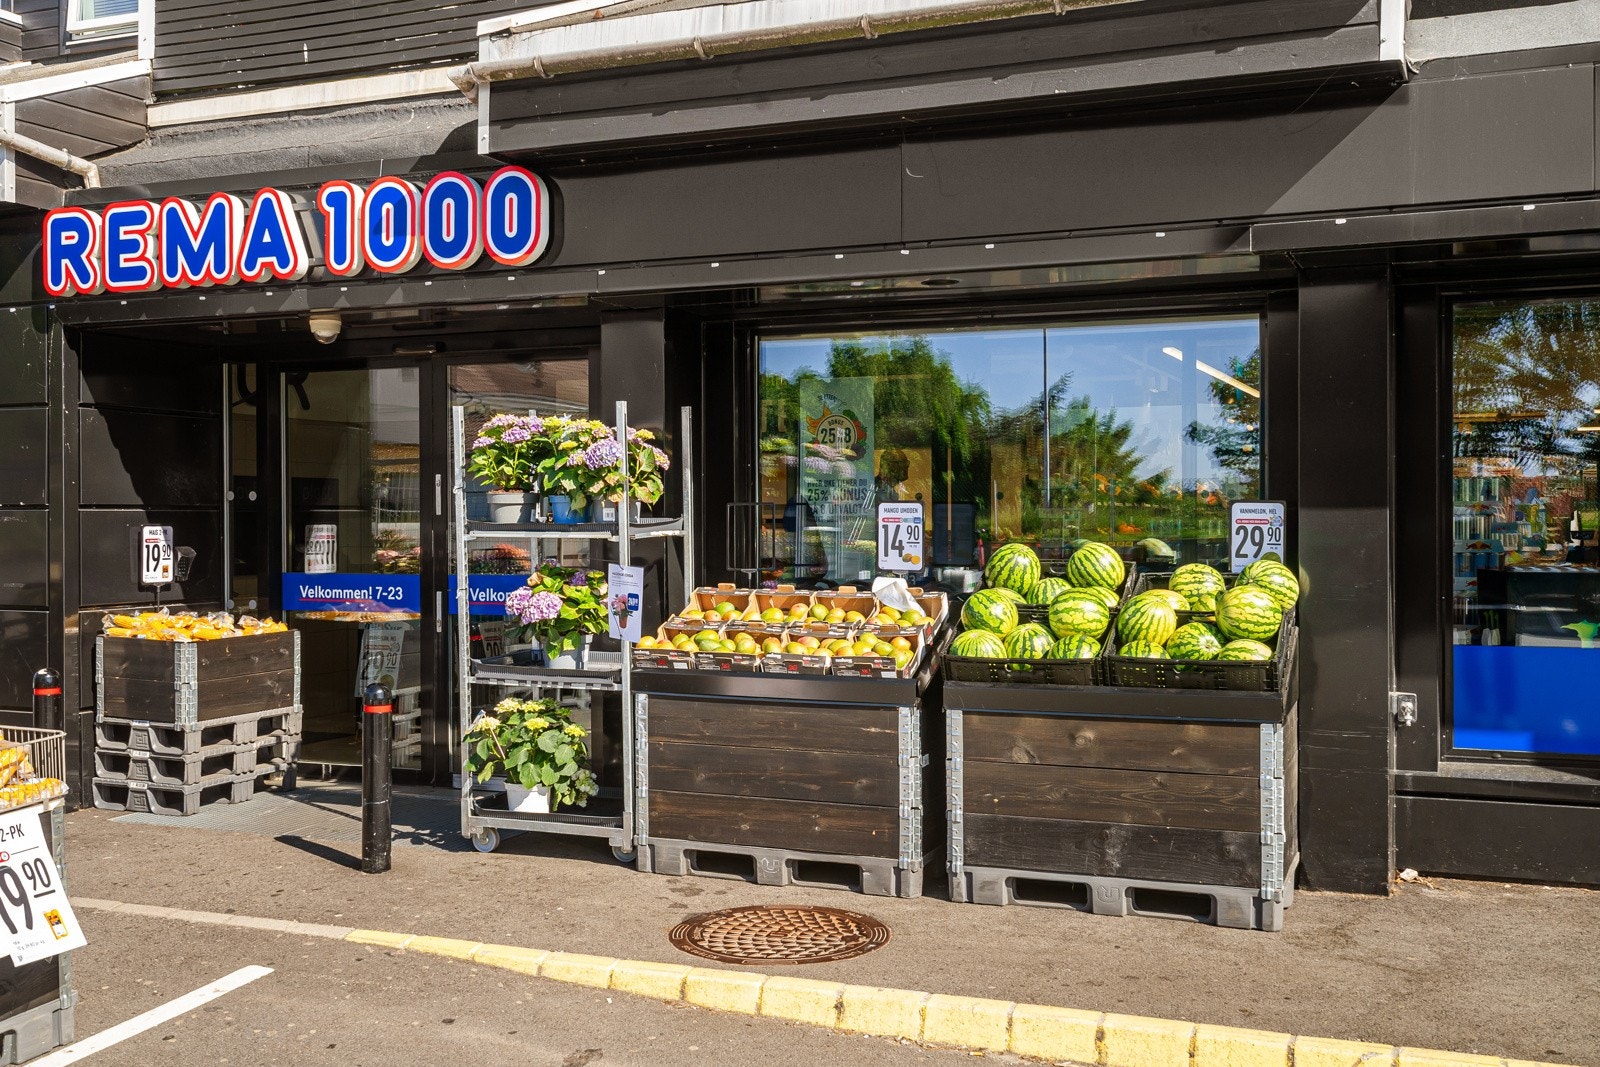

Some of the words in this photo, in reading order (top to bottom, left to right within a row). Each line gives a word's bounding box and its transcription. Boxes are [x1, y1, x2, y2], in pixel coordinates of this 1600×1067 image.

[43, 187, 304, 297] REMA
[318, 166, 543, 277] 1000
[820, 428, 835, 444] 25
[807, 488, 828, 501] 25%
[882, 524, 904, 557] 14
[906, 525, 920, 541] 90
[1235, 525, 1264, 559] 29
[1267, 527, 1281, 542] 90
[145, 544, 160, 572] 19
[162, 544, 171, 557] 90
[299, 585, 373, 600] Velkommen!
[376, 586, 403, 600] 7-23
[21, 857, 51, 891] 90
